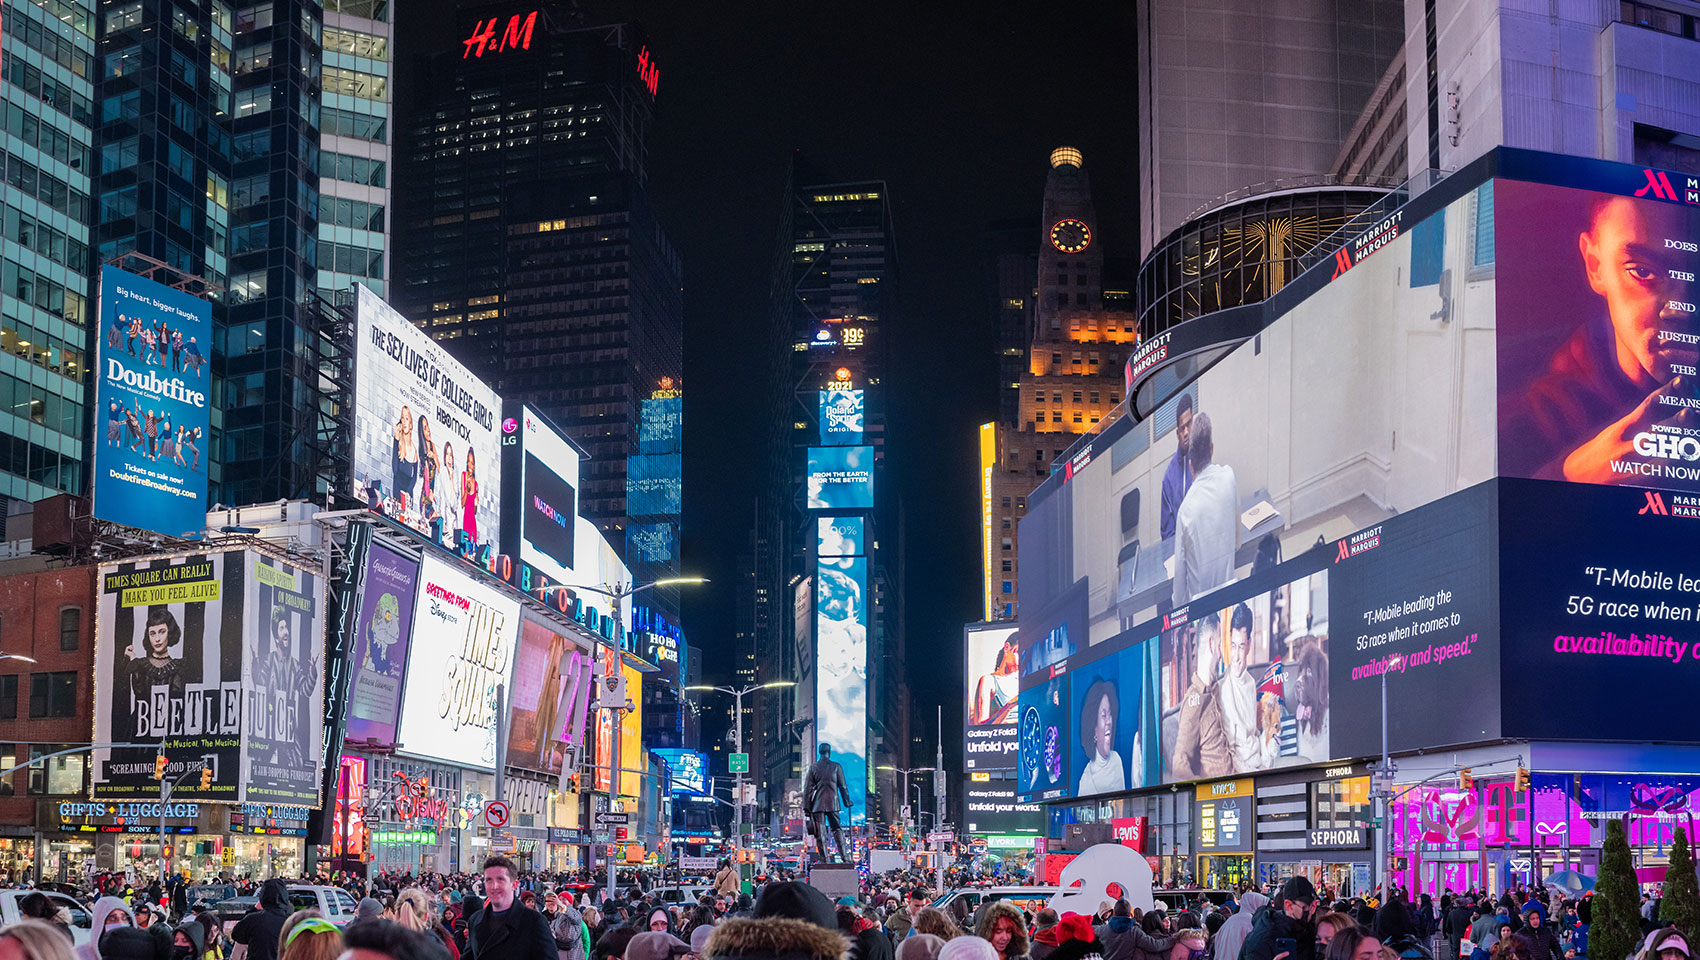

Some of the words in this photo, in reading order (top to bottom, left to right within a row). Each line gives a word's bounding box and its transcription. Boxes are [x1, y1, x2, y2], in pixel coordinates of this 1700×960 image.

[462, 10, 538, 59] H&M
[1355, 210, 1403, 249] MARRIOTT
[1355, 228, 1398, 262] MARQUIS
[1664, 239, 1698, 252] DOES
[1668, 269, 1695, 282] THE
[116, 286, 129, 298] Big
[130, 291, 151, 305] heart,
[153, 299, 176, 313] bigger
[176, 308, 201, 322] laughs.
[1668, 300, 1696, 312] END
[1133, 332, 1172, 364] MARRIOTT
[1133, 349, 1166, 377] MARQUIS
[1670, 364, 1696, 376] THE
[107, 358, 205, 407] Doubtfire
[371, 324, 386, 352] THE
[386, 332, 404, 365] SEX
[404, 345, 429, 382] LIVES
[429, 365, 441, 391] OF
[441, 374, 473, 417] COLLEGE
[473, 399, 493, 432] GIRLS
[827, 381, 853, 391] 2021
[826, 405, 855, 418] Poland
[1659, 395, 1700, 409] MEANS
[1651, 424, 1682, 434] POWER
[502, 436, 517, 445] LG
[1633, 432, 1700, 461] GHO
[124, 463, 147, 475] Tickets
[156, 473, 169, 481] sale
[169, 476, 184, 485] now!
[1610, 459, 1661, 477] WATCH
[1665, 465, 1700, 480] NOW
[109, 468, 197, 499] DoubtfireBroadway.com
[534, 495, 553, 520] WATCH
[553, 510, 567, 528] NOW
[1351, 526, 1383, 545] MARRIOTT
[1351, 538, 1379, 555] MARQUIS
[106, 574, 129, 589] TIMES
[130, 570, 160, 587] SQUARE
[162, 567, 179, 581] CAN
[180, 563, 211, 579] REALLY
[1585, 566, 1674, 590] “T-Mobile
[125, 590, 148, 604] MAKE
[149, 588, 166, 601] YOU
[168, 586, 188, 600] FEEL
[190, 584, 218, 598] ALIVE!
[277, 590, 285, 603] ON
[425, 582, 455, 606] GREETINGS
[455, 594, 471, 611] FROM
[1363, 603, 1402, 626] “T-Mobile
[1402, 595, 1435, 615] leading
[1436, 589, 1452, 606] the
[1566, 595, 1594, 615] 5G
[1598, 602, 1640, 618] race
[1644, 601, 1691, 621] when
[1356, 634, 1369, 651] 5G
[1369, 635, 1387, 648] race
[1388, 626, 1410, 642] when
[1411, 621, 1418, 636] it
[1419, 616, 1449, 634] comes
[1450, 611, 1461, 626] to
[1410, 644, 1432, 667] and
[1433, 633, 1478, 665] speed.”
[1272, 671, 1289, 685] love
[136, 684, 241, 737] BEETLE
[967, 729, 992, 739] Galaxy
[991, 729, 998, 737] Z
[999, 728, 1018, 736] Fold3
[201, 739, 212, 748] The
[214, 739, 241, 747] Musical.
[967, 741, 1001, 753] Unfold
[1325, 766, 1352, 778] SEPHORA
[59, 802, 105, 817] GIFTS
[118, 803, 200, 818] LUGGAGE
[241, 803, 267, 818] GIFTS
[272, 805, 310, 821] LUGGAGE
[968, 803, 995, 811] Unfold
[995, 804, 1014, 813] your
[1015, 803, 1041, 812] world.
[101, 825, 124, 833] Canon
[1202, 829, 1216, 842] SALE
[1311, 829, 1361, 846] SEPHORA
